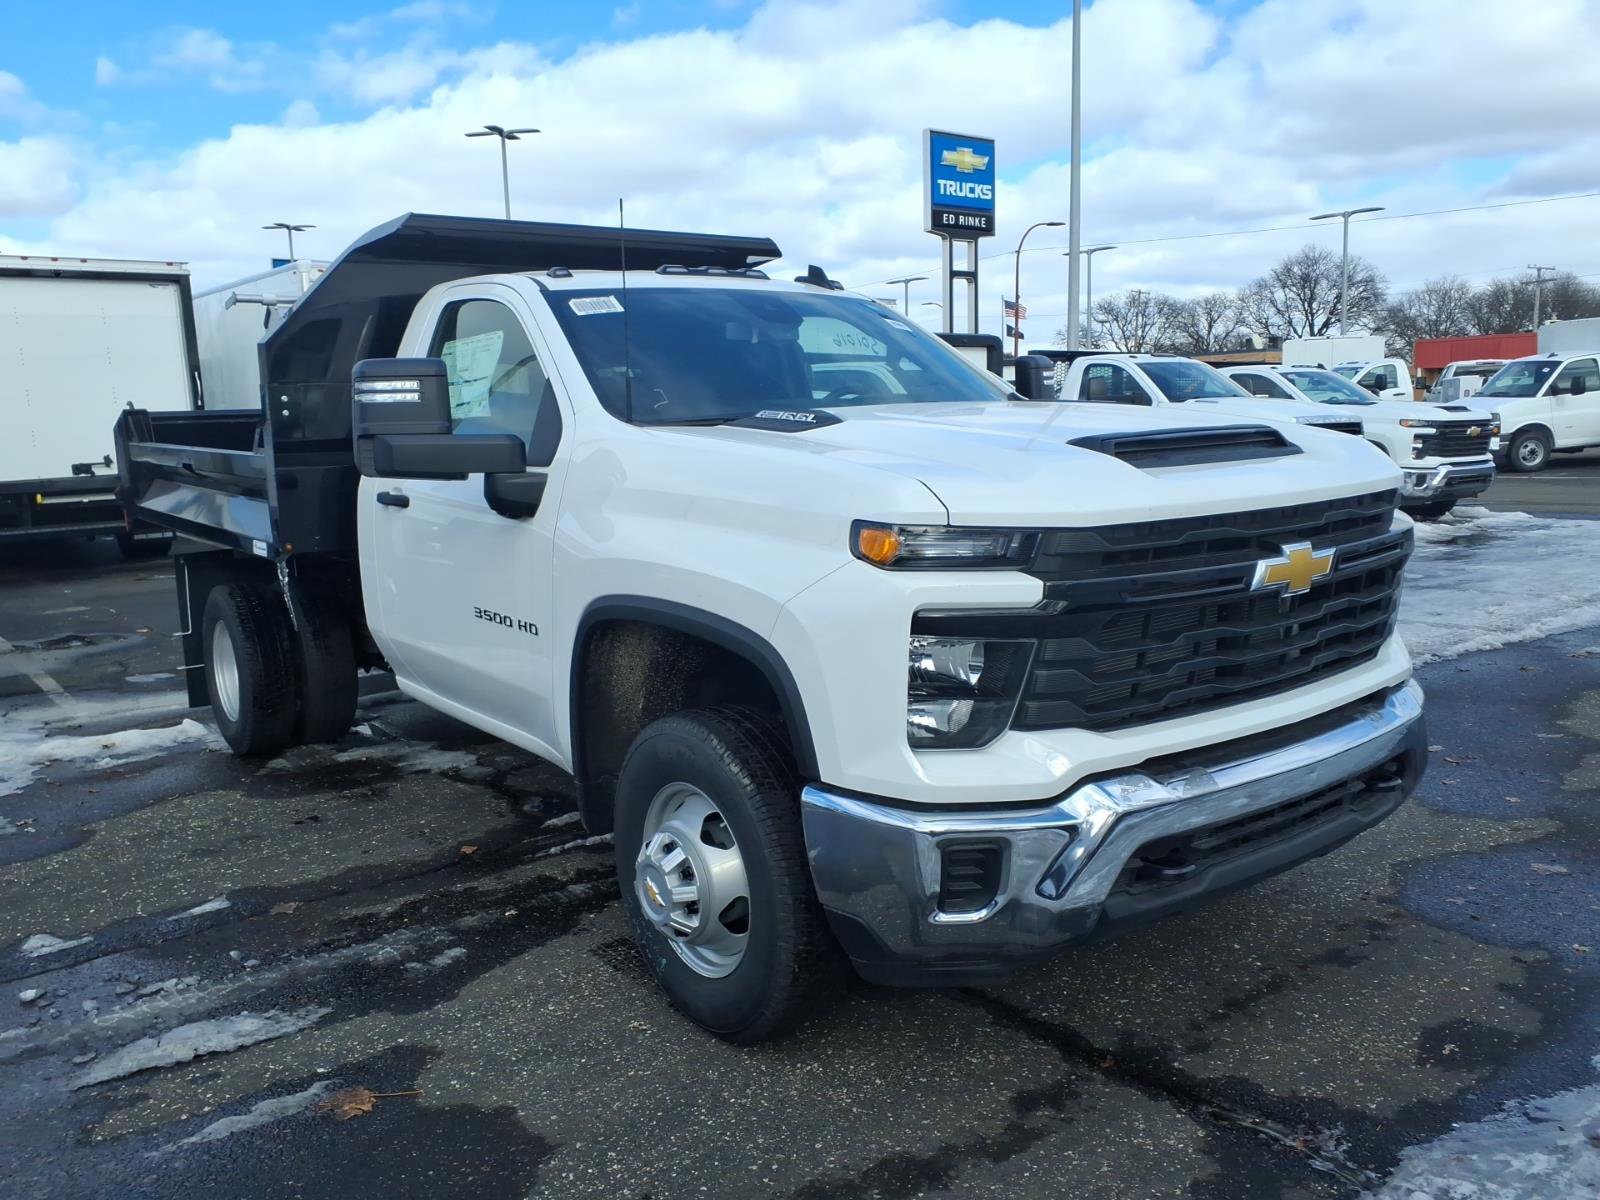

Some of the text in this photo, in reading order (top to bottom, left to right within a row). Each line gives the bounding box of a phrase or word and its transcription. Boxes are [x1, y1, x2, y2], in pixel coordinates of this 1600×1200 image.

[937, 179, 992, 200] TRUCKS
[943, 213, 987, 228] ED RINKE
[474, 606, 539, 636] 3500 HD
